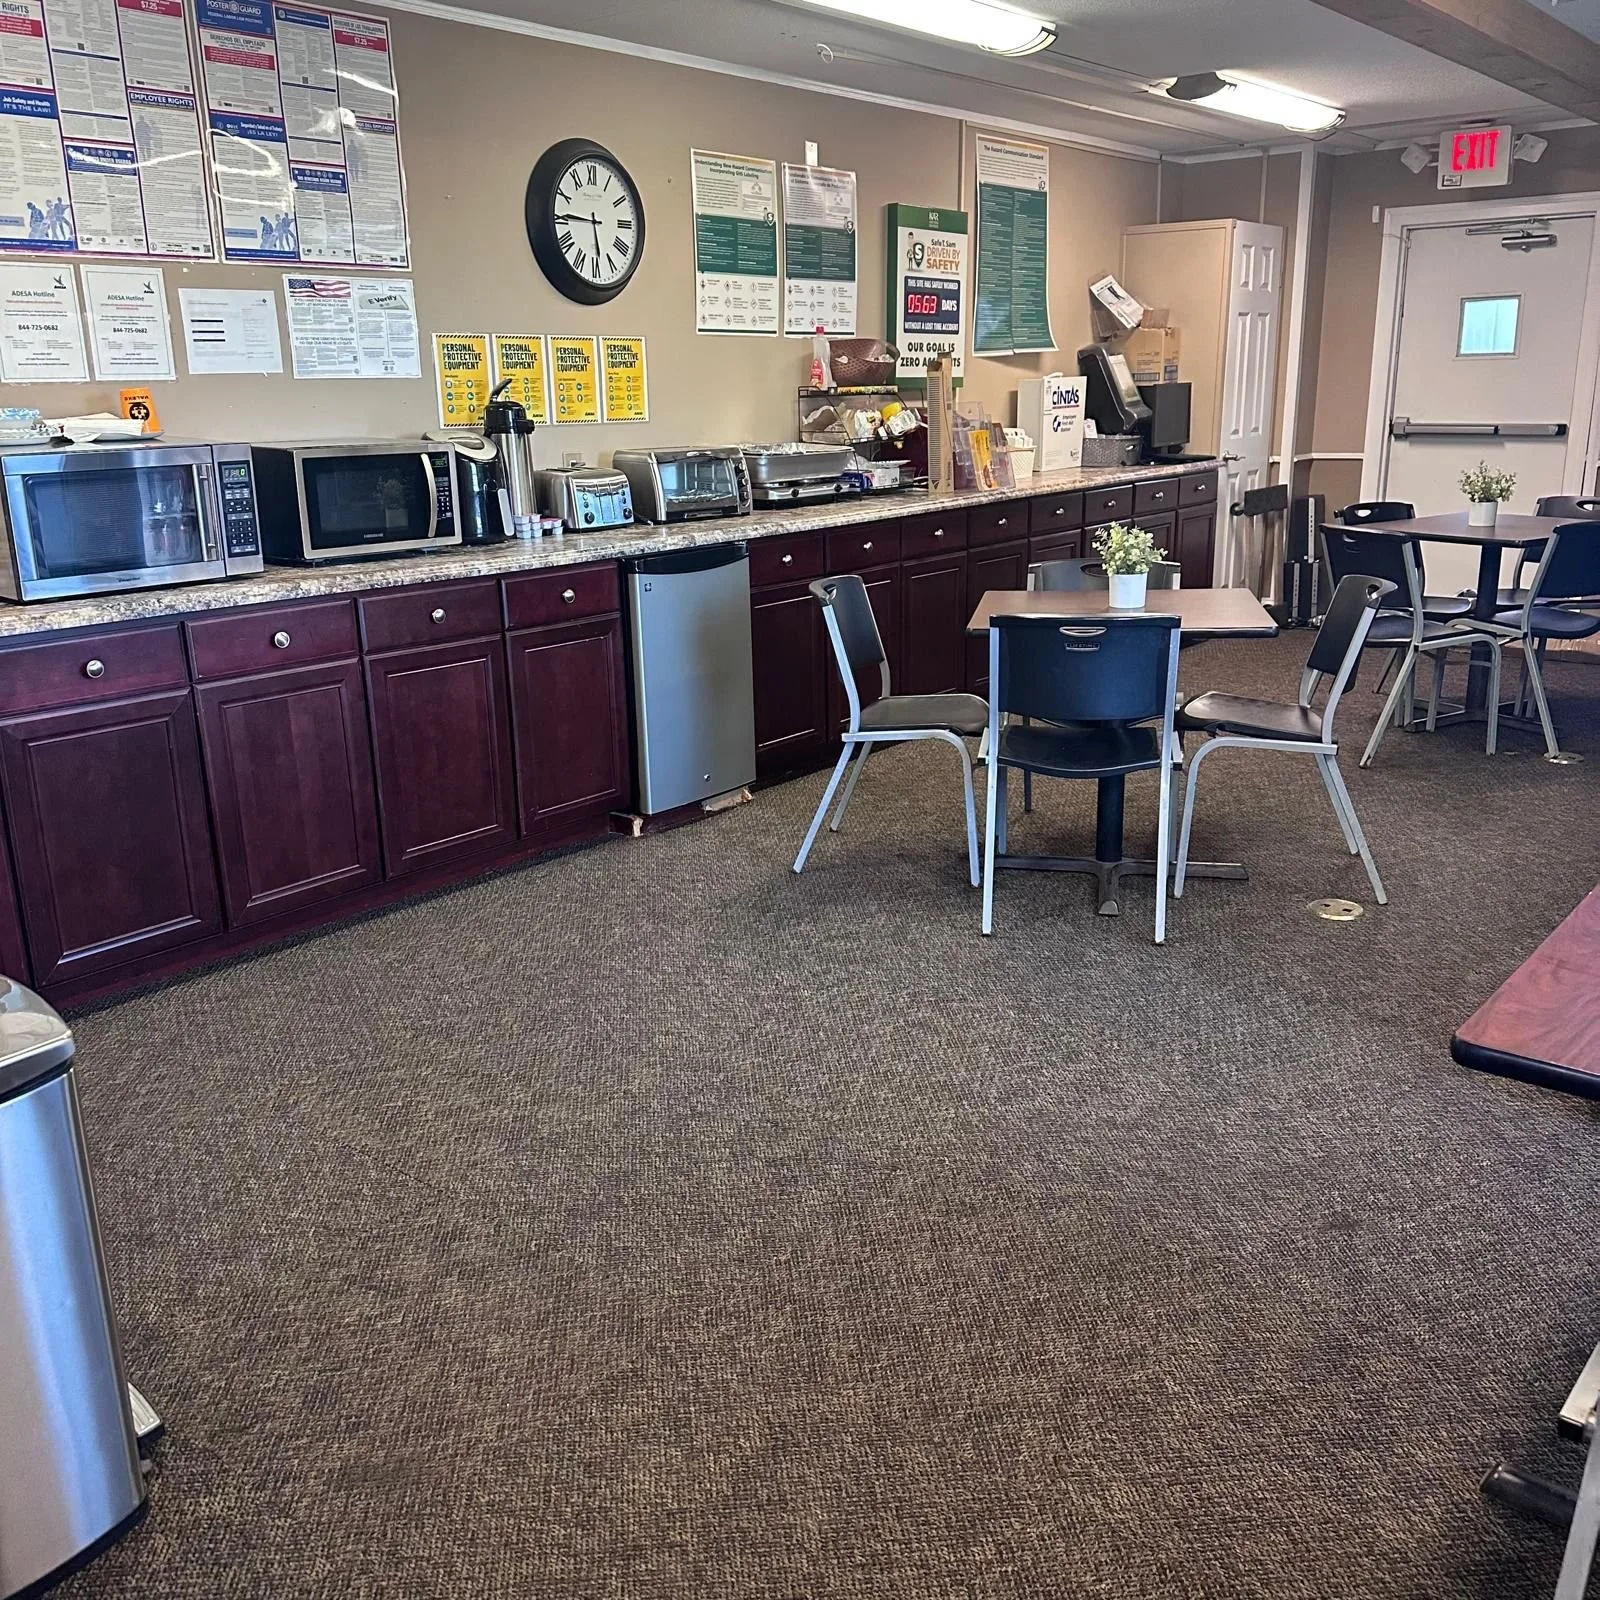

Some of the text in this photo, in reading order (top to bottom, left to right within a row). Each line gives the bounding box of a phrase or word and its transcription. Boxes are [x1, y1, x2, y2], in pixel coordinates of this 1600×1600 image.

[2, 3, 29, 14] RIGHTS
[207, 0, 261, 15] POSTER GUARD
[131, 93, 166, 103] EMPLOYEE
[168, 97, 193, 106] RIGHTS
[1452, 130, 1500, 172] EXIT
[927, 247, 960, 259] DRIVEN BY
[927, 258, 960, 271] SAFETY
[908, 295, 957, 314] 0563 DAYS
[442, 344, 475, 352] PERSONAL
[501, 343, 531, 352] PERSONAL
[556, 347, 584, 355] PERSONAL
[607, 344, 634, 352] PERSONAL
[908, 342, 955, 353] OUR GOAL IS
[443, 353, 482, 361] PROTECTIVE
[502, 352, 537, 361] PROTECTIVE
[557, 356, 590, 364] PROTECTIVE
[444, 361, 479, 371] EQUIPMENT
[503, 361, 534, 370] EQUIPMENT
[608, 361, 636, 369] EQUIPMENT
[900, 357, 920, 367] ZERO
[558, 364, 587, 373] EQUIPMENT
[1052, 385, 1080, 405] CINTAS
